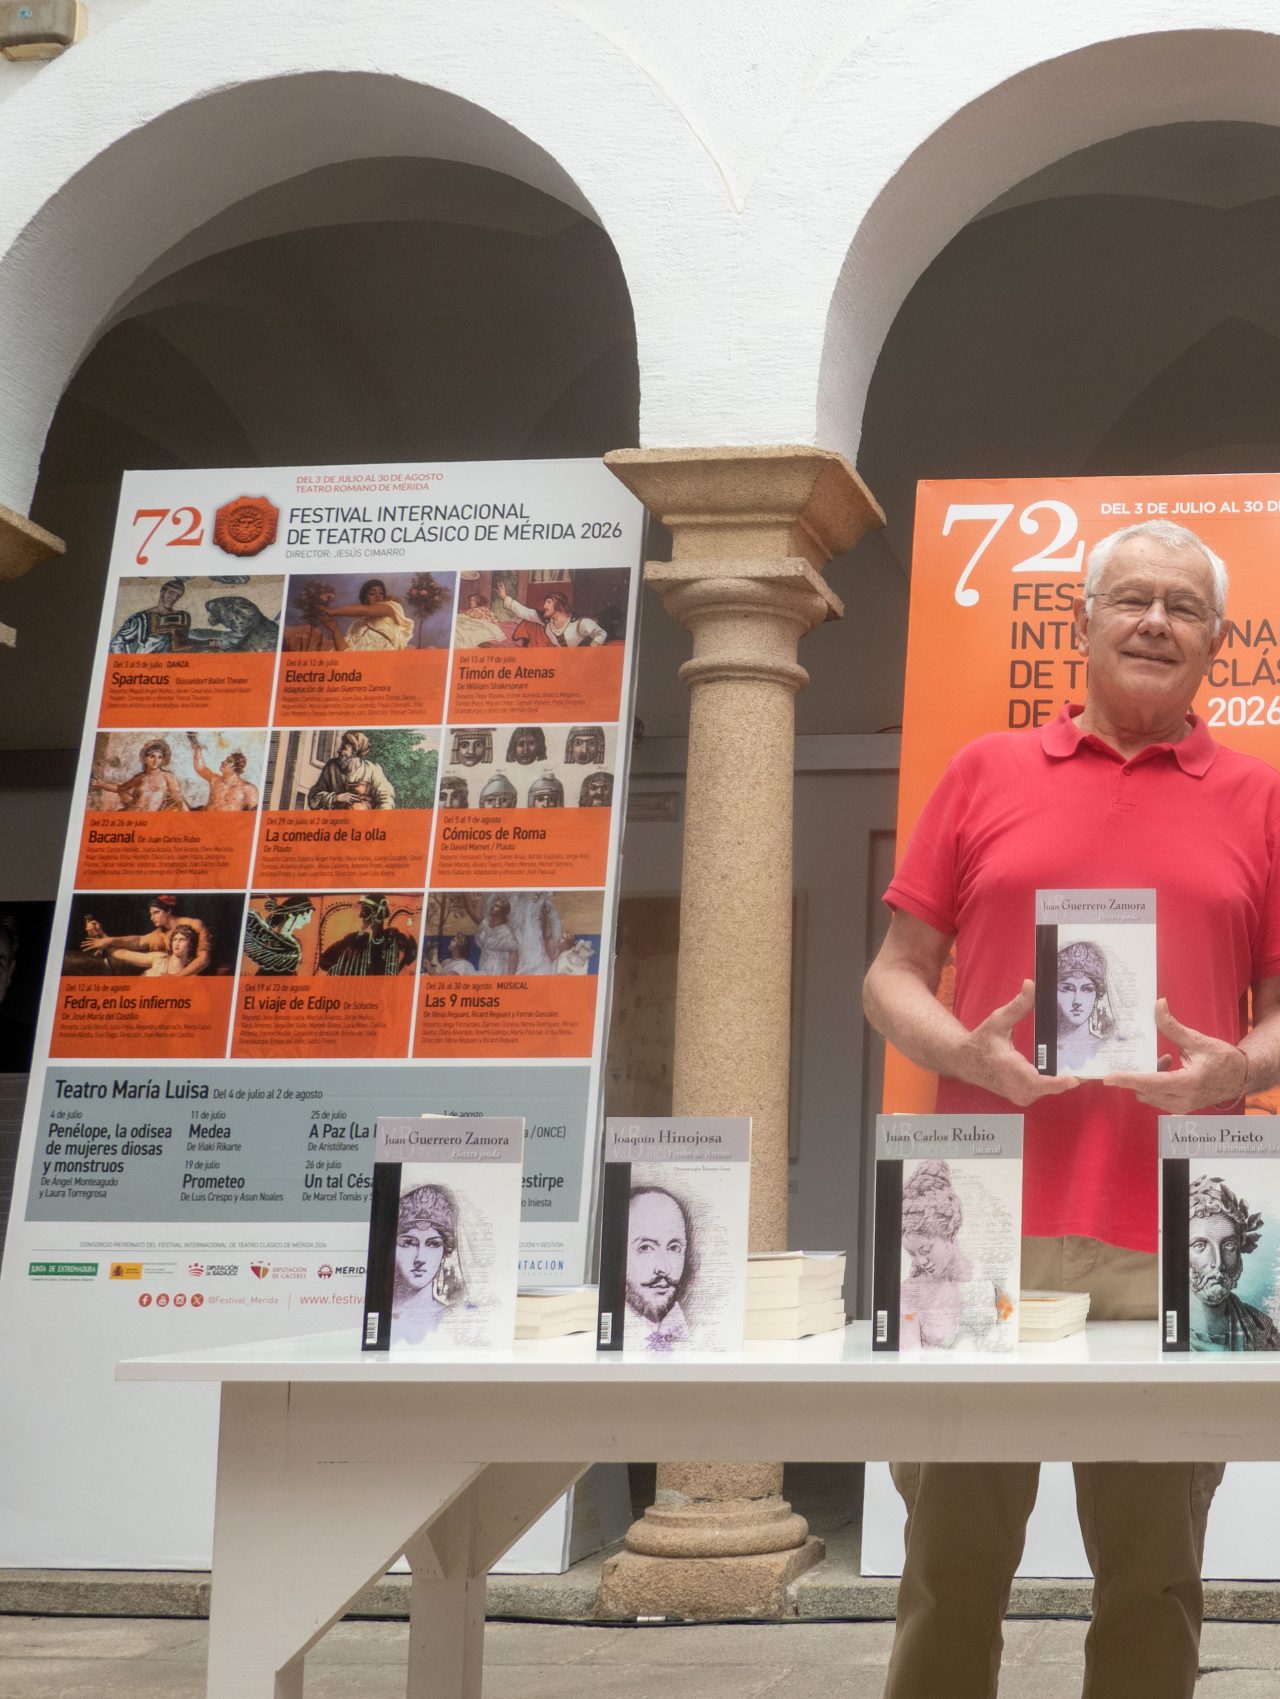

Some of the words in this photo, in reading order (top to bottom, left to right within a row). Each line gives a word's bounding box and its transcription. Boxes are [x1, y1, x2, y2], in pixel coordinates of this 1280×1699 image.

[297, 475, 314, 484] DEL
[316, 475, 322, 484] 3
[324, 475, 336, 483] DE
[337, 474, 363, 484] JULIO
[364, 474, 376, 482] AL
[378, 474, 389, 482] 30
[390, 474, 402, 482] DE
[404, 473, 444, 482] AGOSTO
[296, 485, 332, 494] TEATRO
[333, 484, 376, 493] ROMANO
[378, 483, 392, 492] DE
[392, 481, 430, 492] MÉRIDA
[290, 506, 372, 524] FESTIVAL
[378, 503, 531, 522] INTERNACIONAL
[1100, 503, 1131, 515] DEL
[1134, 502, 1144, 514] 3
[1147, 502, 1168, 514] DE
[1171, 502, 1216, 514] JULIO
[1220, 501, 1241, 513] AL
[1244, 500, 1264, 513] 30
[132, 506, 205, 565] 72
[287, 529, 310, 545] DE
[316, 527, 386, 545] TEATRO
[390, 522, 470, 544] CLÁSICO
[475, 525, 499, 541] DE
[504, 520, 576, 541] MÉRIDA
[580, 522, 623, 540] 2026
[286, 549, 332, 559] DIRECTOR:
[334, 547, 362, 558] JESÚS
[364, 548, 406, 558] CIMARRO
[942, 500, 1086, 608] 72
[112, 672, 170, 688] Spartacus
[286, 670, 325, 683] Electra
[328, 669, 362, 682] Jonda
[459, 666, 494, 680] Timón
[498, 667, 512, 680] de
[514, 666, 556, 679] Atenas
[1009, 660, 1054, 689] DE
[1008, 699, 1053, 728] DE
[88, 830, 136, 844] Bacanal
[266, 828, 280, 842] La
[282, 828, 331, 842] comedia
[334, 829, 348, 841] de
[351, 828, 362, 840] la
[364, 828, 386, 840] olla
[442, 826, 492, 840] Cómicos
[495, 827, 508, 840] de
[512, 827, 546, 840] Roma
[1061, 898, 1106, 910] Guerrero
[1108, 898, 1146, 910] Zamora
[496, 982, 528, 990] MUSICAL
[64, 995, 100, 1010] Fedra,
[102, 998, 116, 1009] en
[119, 995, 136, 1009] los
[139, 995, 191, 1009] infiernos
[244, 996, 256, 1010] El
[259, 996, 286, 1012] viaje
[290, 996, 304, 1010] de
[308, 996, 340, 1012] Edipo
[425, 994, 446, 1008] Las
[450, 994, 457, 1008] 9
[460, 996, 500, 1008] musas
[56, 1079, 108, 1100] Teatro
[112, 1078, 160, 1100] María
[165, 1080, 209, 1100] Luisa
[213, 1088, 227, 1100] Del
[228, 1089, 234, 1099] 4
[236, 1088, 246, 1099] de
[247, 1088, 265, 1102] julio
[267, 1088, 274, 1099] al
[276, 1089, 282, 1099] 2
[283, 1088, 294, 1099] de
[295, 1090, 323, 1102] agosto
[48, 1122, 111, 1142] Penélope,
[115, 1124, 127, 1138] la
[130, 1124, 172, 1138] odisea
[188, 1124, 231, 1138] Medea
[308, 1124, 319, 1138] A
[322, 1124, 346, 1138] Paz
[350, 1122, 370, 1140] (La
[384, 1134, 406, 1146] Juan
[408, 1131, 462, 1146] Guerrero
[464, 1131, 510, 1146] Zamora
[612, 1133, 655, 1146] Joaquín
[658, 1130, 722, 1146] Hinojosa
[886, 1131, 910, 1142] Juan
[914, 1129, 948, 1142] Carlos
[952, 1126, 995, 1142] Rubio
[1171, 1132, 1216, 1143] Antonio
[1220, 1129, 1264, 1143] Prieto
[46, 1140, 62, 1156] de
[64, 1141, 118, 1158] mujeres
[121, 1141, 163, 1156] diosas
[187, 1142, 196, 1151] De
[216, 1142, 242, 1151] Rikarte
[308, 1142, 318, 1151] De
[318, 1142, 358, 1151] Aristófanes
[42, 1161, 51, 1176] y
[54, 1159, 124, 1173] monstruos
[182, 1174, 246, 1188] Prometeo
[304, 1174, 322, 1189] Un
[326, 1174, 343, 1188] tal
